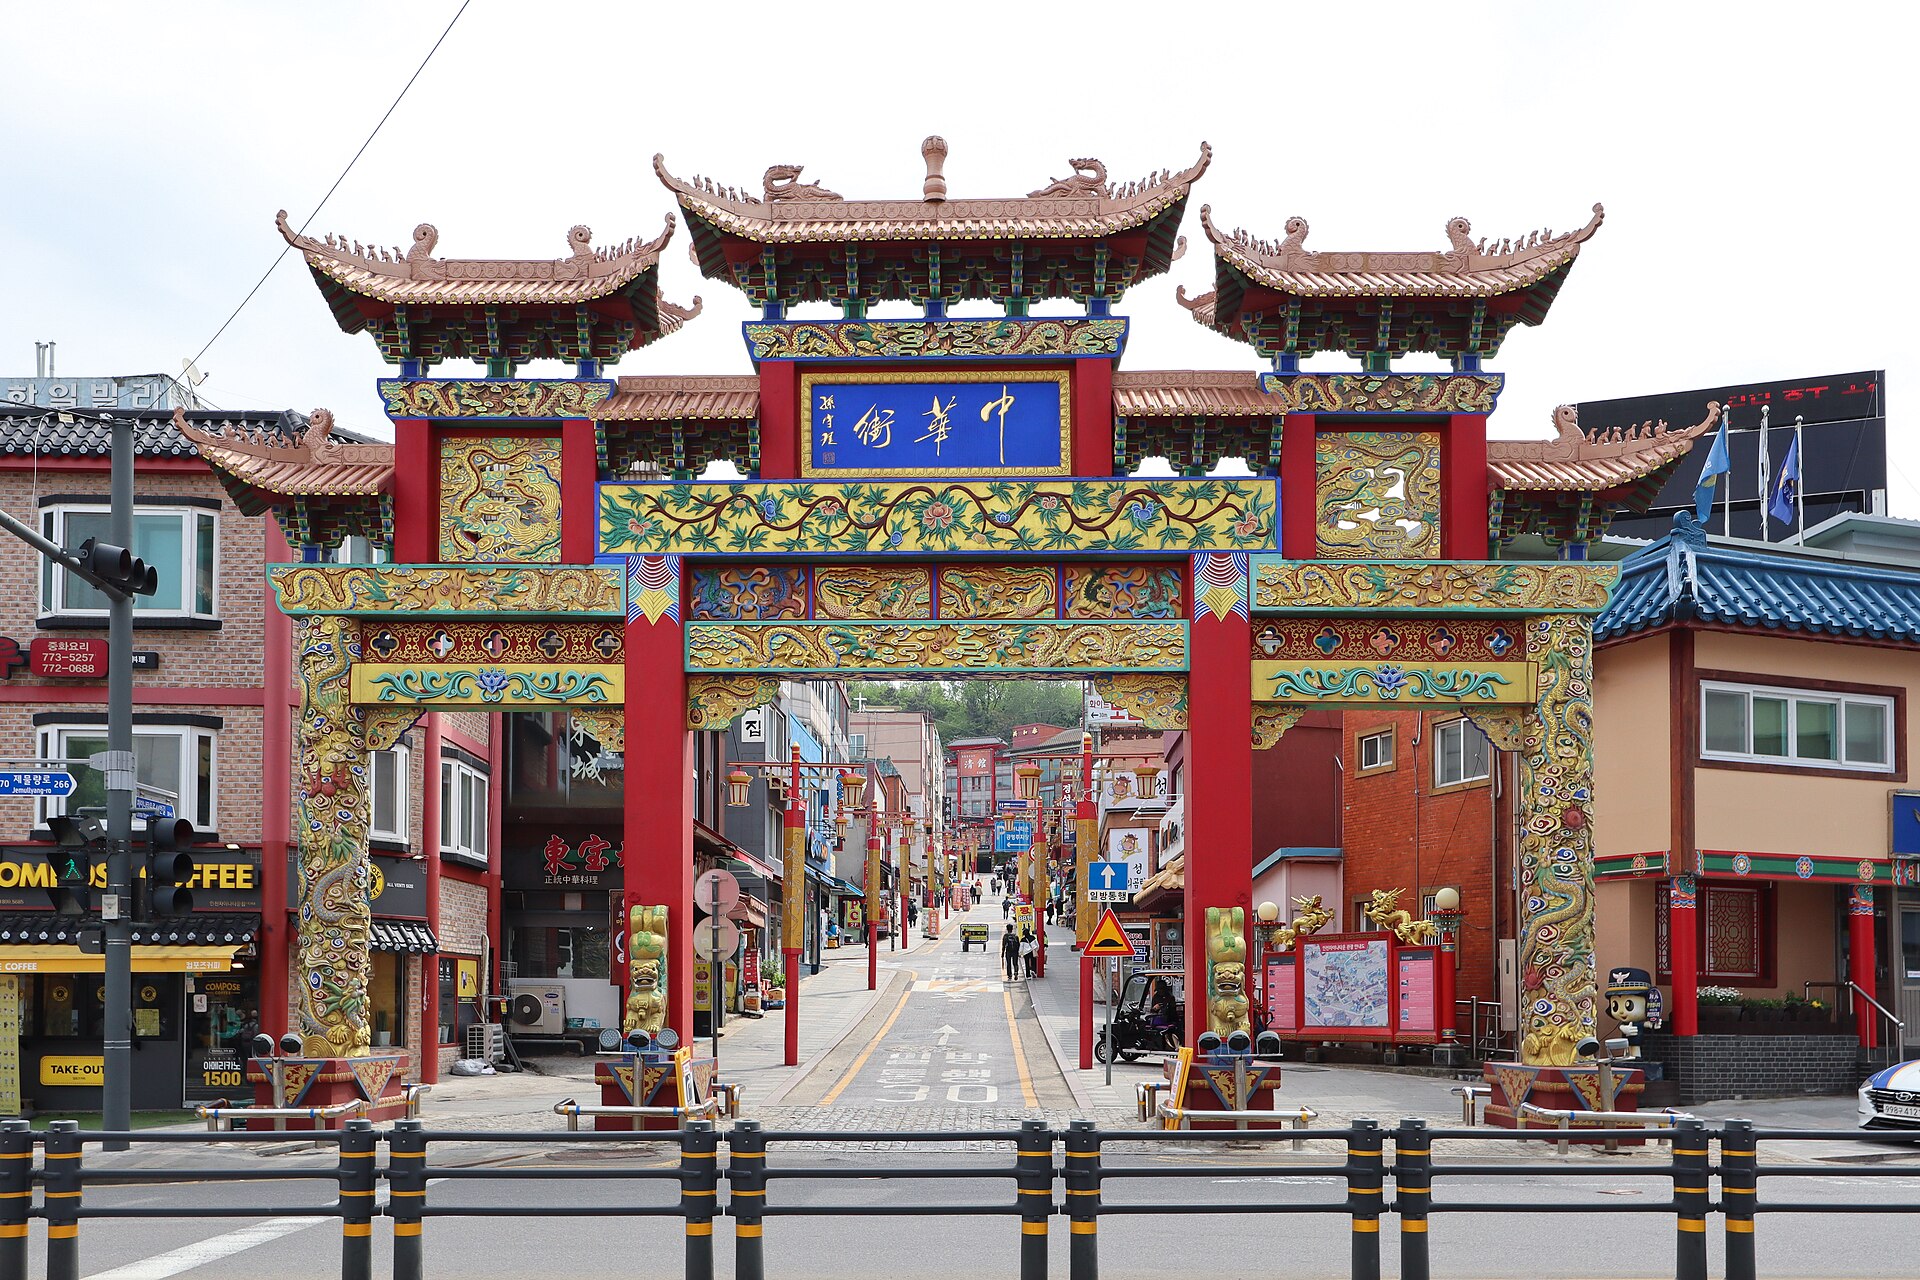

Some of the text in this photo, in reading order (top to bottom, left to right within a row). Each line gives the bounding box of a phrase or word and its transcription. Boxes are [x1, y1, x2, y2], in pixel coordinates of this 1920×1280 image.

[48, 642, 89, 652] 중화요리
[42, 653, 94, 662] 773-5257
[42, 664, 95, 673] 772-0688
[13, 774, 70, 789] 제물량로 266
[12, 787, 52, 795] Jemullyang-ro
[1090, 891, 1127, 901] 일방통행
[4, 962, 37, 971] COFFEE
[186, 961, 221, 970] 컴포즈커피
[205, 982, 240, 991] COMPOSE
[203, 1061, 241, 1070] 아메리카노
[203, 1071, 241, 1086] 1500
